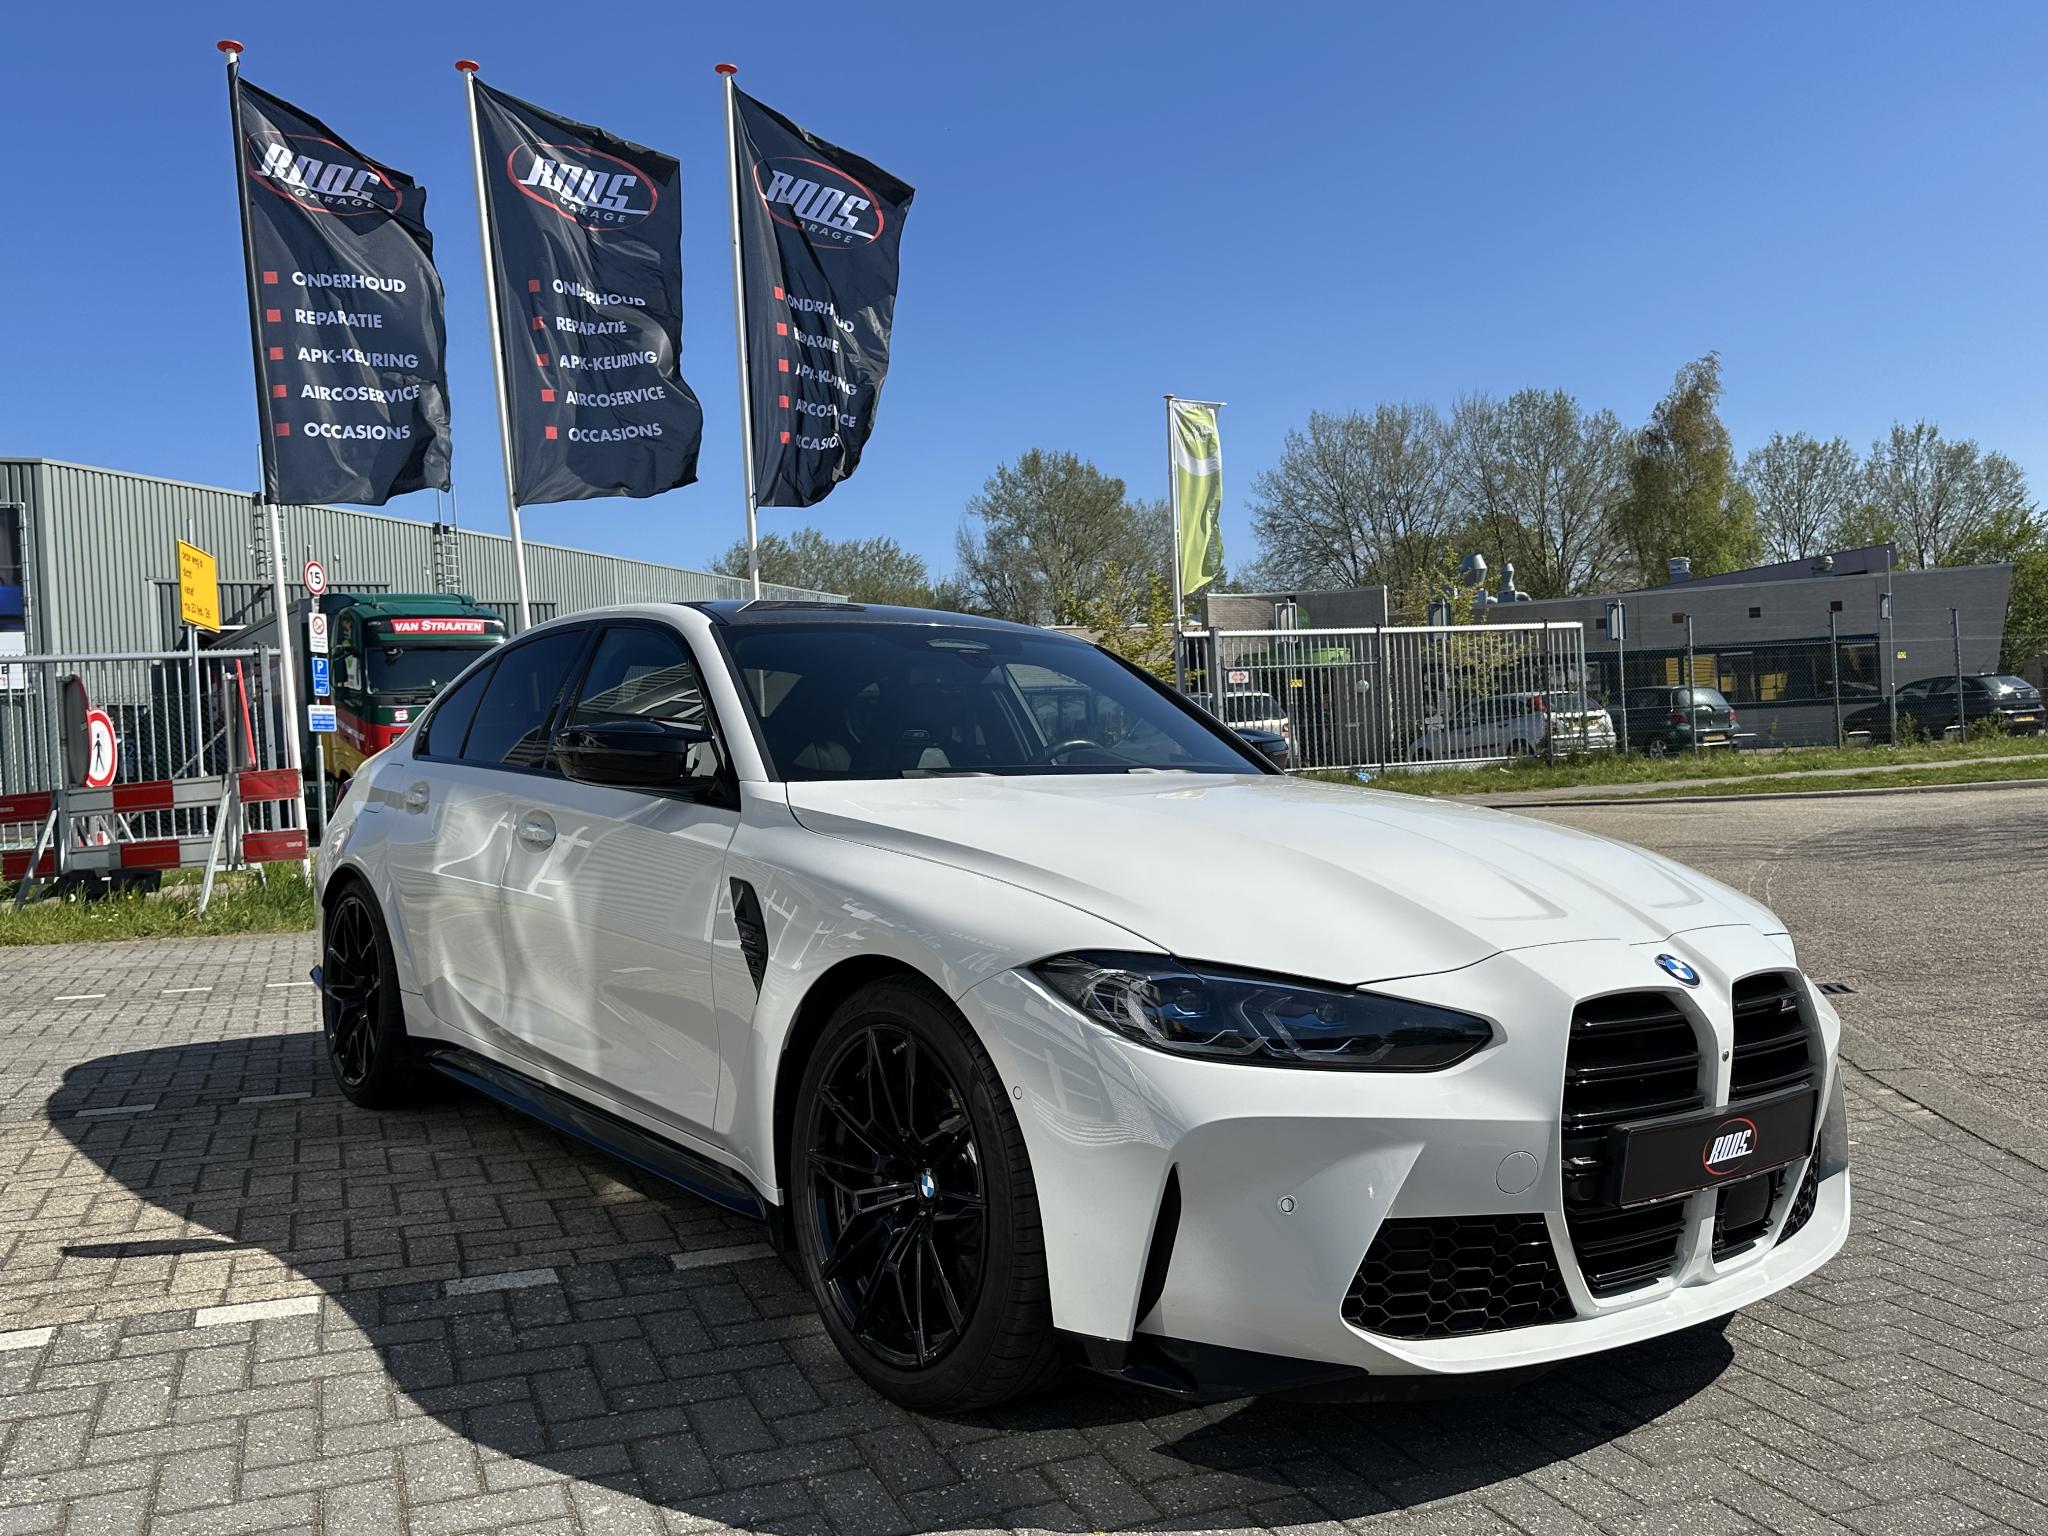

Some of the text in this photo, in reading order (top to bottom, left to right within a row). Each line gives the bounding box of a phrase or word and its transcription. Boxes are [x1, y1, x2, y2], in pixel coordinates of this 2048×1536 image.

[560, 197, 627, 223] GARAGE
[764, 170, 870, 231] ROOS
[799, 219, 853, 244] ARAGE
[291, 271, 407, 293] ONDERHOUD
[294, 308, 383, 328] REPARATIE
[556, 316, 628, 336] REPARATIE
[297, 346, 419, 368] APK-KEURING
[559, 350, 658, 371] APK-KEURING
[301, 384, 420, 404] AIRCOSERVICE
[565, 386, 666, 408] AIRCOSERVICE
[303, 422, 411, 440] OCCASIONS
[568, 422, 663, 443] OCCASIONS
[310, 571, 322, 585] 15
[394, 620, 482, 632] VAN STRAATEN
[316, 660, 324, 674] P
[1705, 1129, 1753, 1165] ROOS
